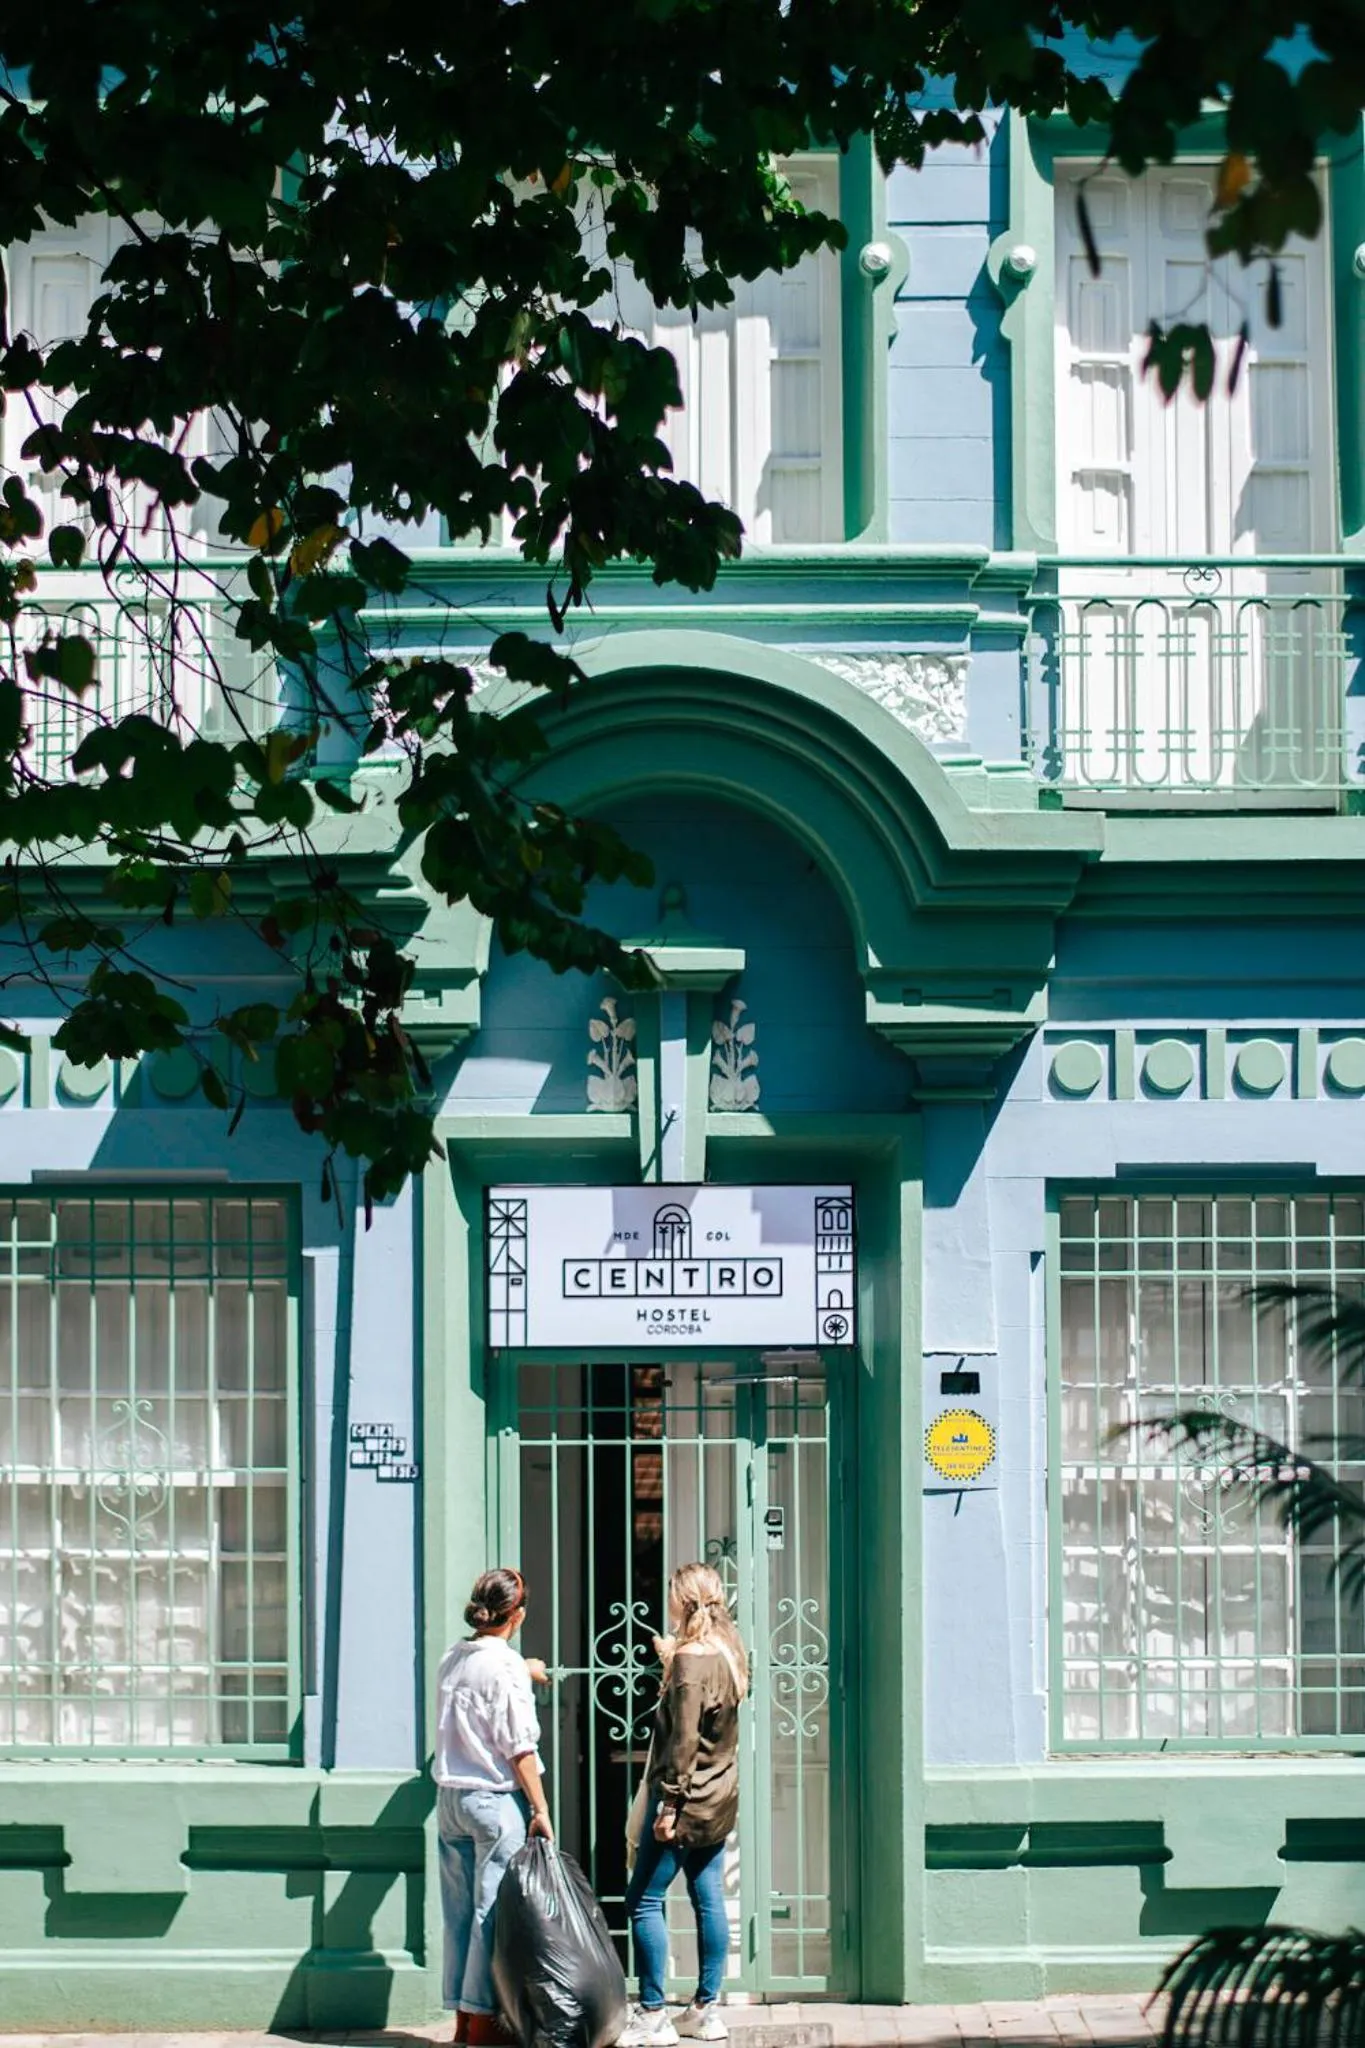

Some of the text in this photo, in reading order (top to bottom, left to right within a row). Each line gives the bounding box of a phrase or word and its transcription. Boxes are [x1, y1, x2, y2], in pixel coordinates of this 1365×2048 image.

[613, 1231, 731, 1241] MDE COL
[573, 1267, 774, 1289] CENTRO
[636, 1309, 711, 1321] HOSTEL
[646, 1324, 702, 1335] CORDOBA
